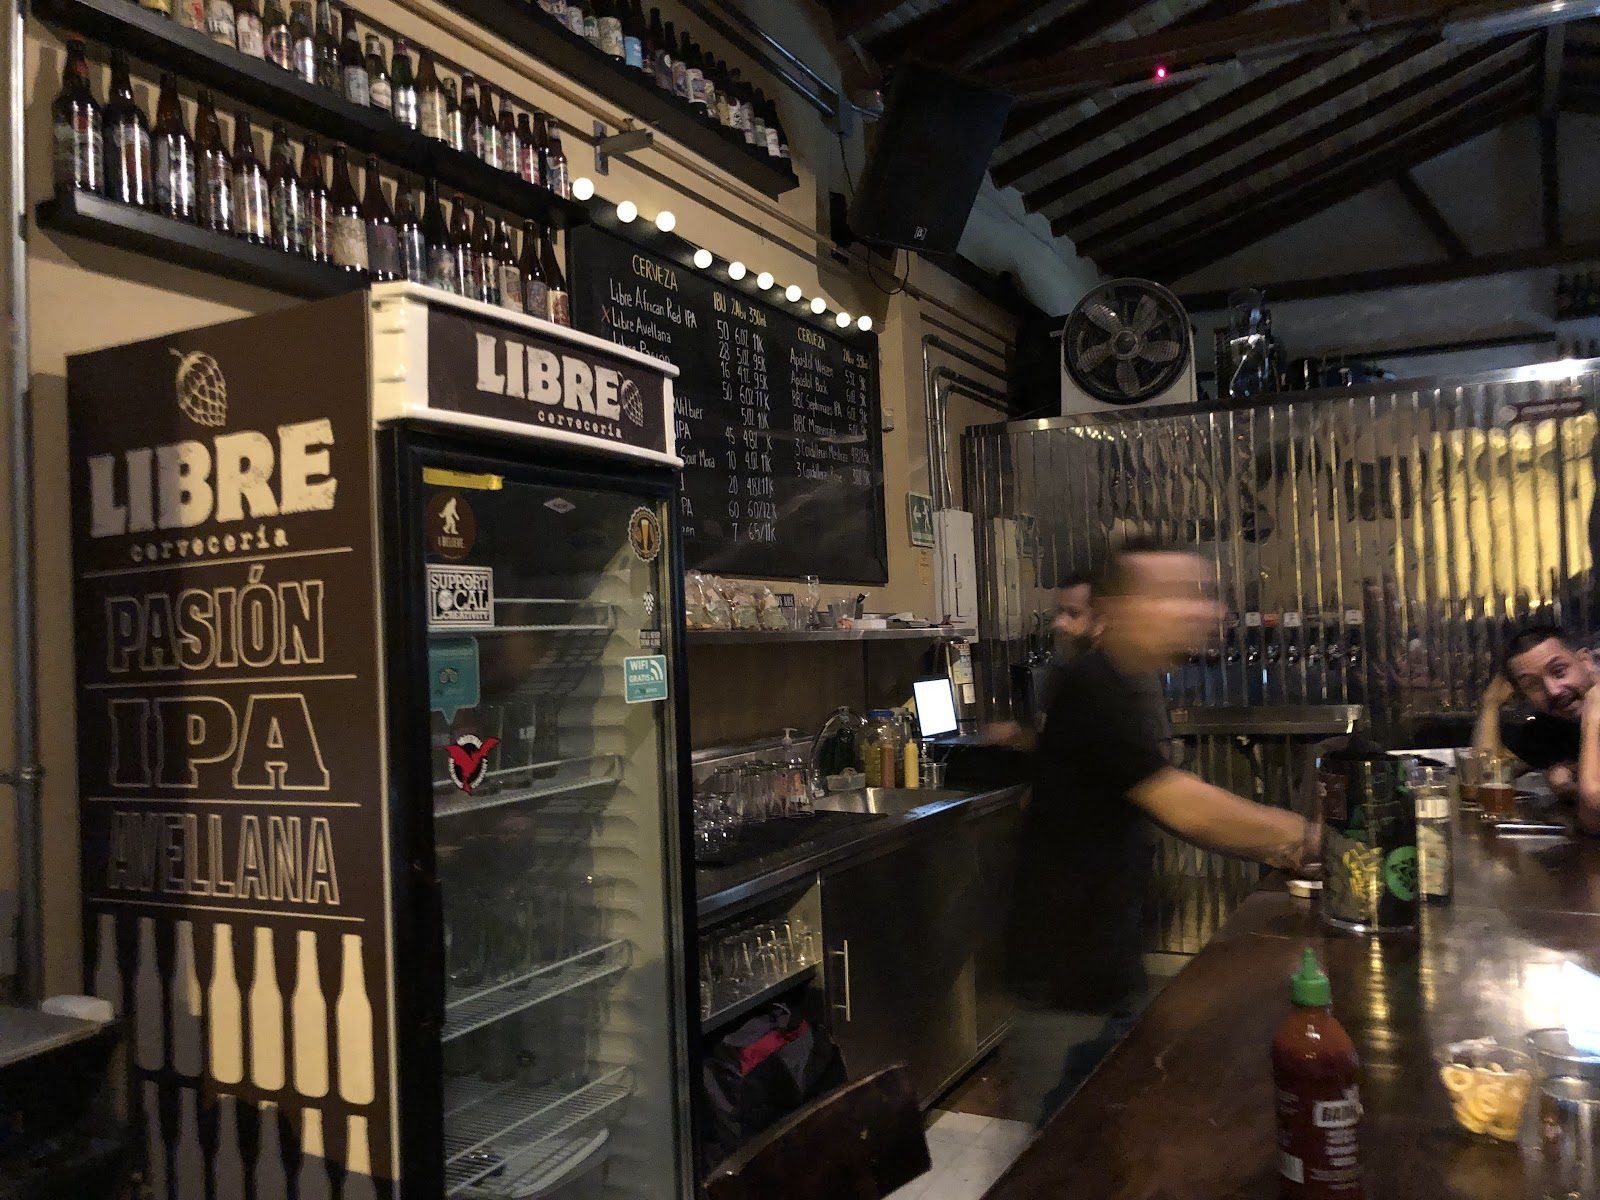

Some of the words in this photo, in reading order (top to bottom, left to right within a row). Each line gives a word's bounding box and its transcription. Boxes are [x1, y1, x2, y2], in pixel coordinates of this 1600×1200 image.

[632, 254, 679, 292] CERVEZA
[610, 278, 632, 308] Libre
[636, 286, 665, 316] African
[666, 297, 681, 325] Red
[685, 309, 698, 328] IPA
[717, 320, 730, 340] 50
[612, 306, 635, 332] Libre
[636, 316, 672, 344] Avellana
[719, 341, 730, 361] 28
[798, 327, 826, 351] CERVEZA
[476, 332, 621, 421] LIBRE
[720, 361, 731, 379] 16
[722, 381, 733, 401] 50
[88, 417, 339, 538] LIBRE
[728, 475, 738, 495] 20
[728, 500, 740, 518] 60
[732, 523, 738, 542] 7
[430, 574, 490, 590] SUPPORT
[104, 564, 324, 673] PASIÓN
[108, 693, 330, 791] IPA
[108, 810, 341, 906] AVELLANA
